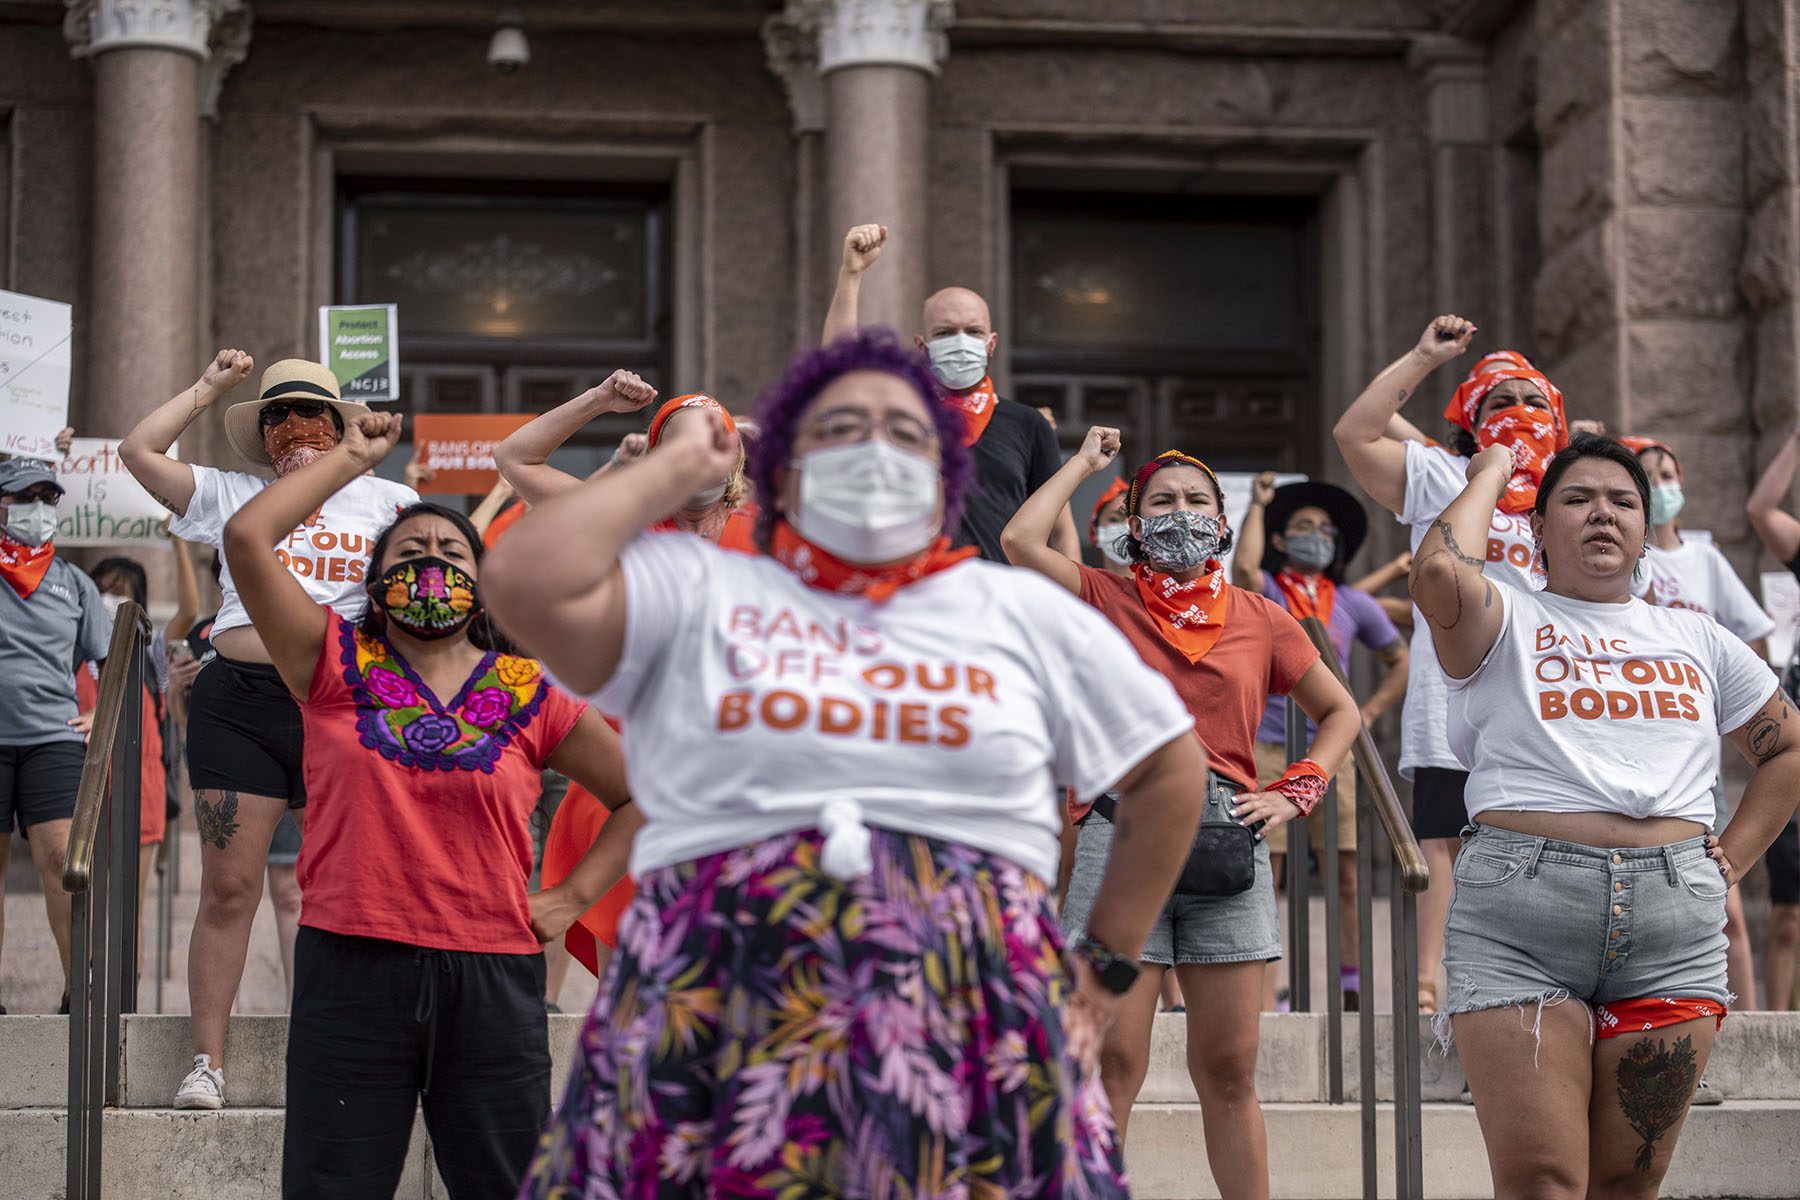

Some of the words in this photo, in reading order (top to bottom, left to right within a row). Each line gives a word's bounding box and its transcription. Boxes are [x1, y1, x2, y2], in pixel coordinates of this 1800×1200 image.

[335, 333, 384, 345] Abortion
[339, 320, 378, 330] Protect
[340, 349, 379, 360] Access
[428, 440, 469, 456] BANS
[428, 456, 464, 470] OUR
[275, 549, 366, 584] ODIES
[730, 605, 883, 656] BANS
[725, 643, 841, 685] OFF
[861, 661, 999, 705] OUR
[1535, 655, 1612, 685] OFF
[1621, 659, 1705, 695] OUR
[715, 687, 972, 749] BODIES
[1539, 687, 1700, 722] BODIES
